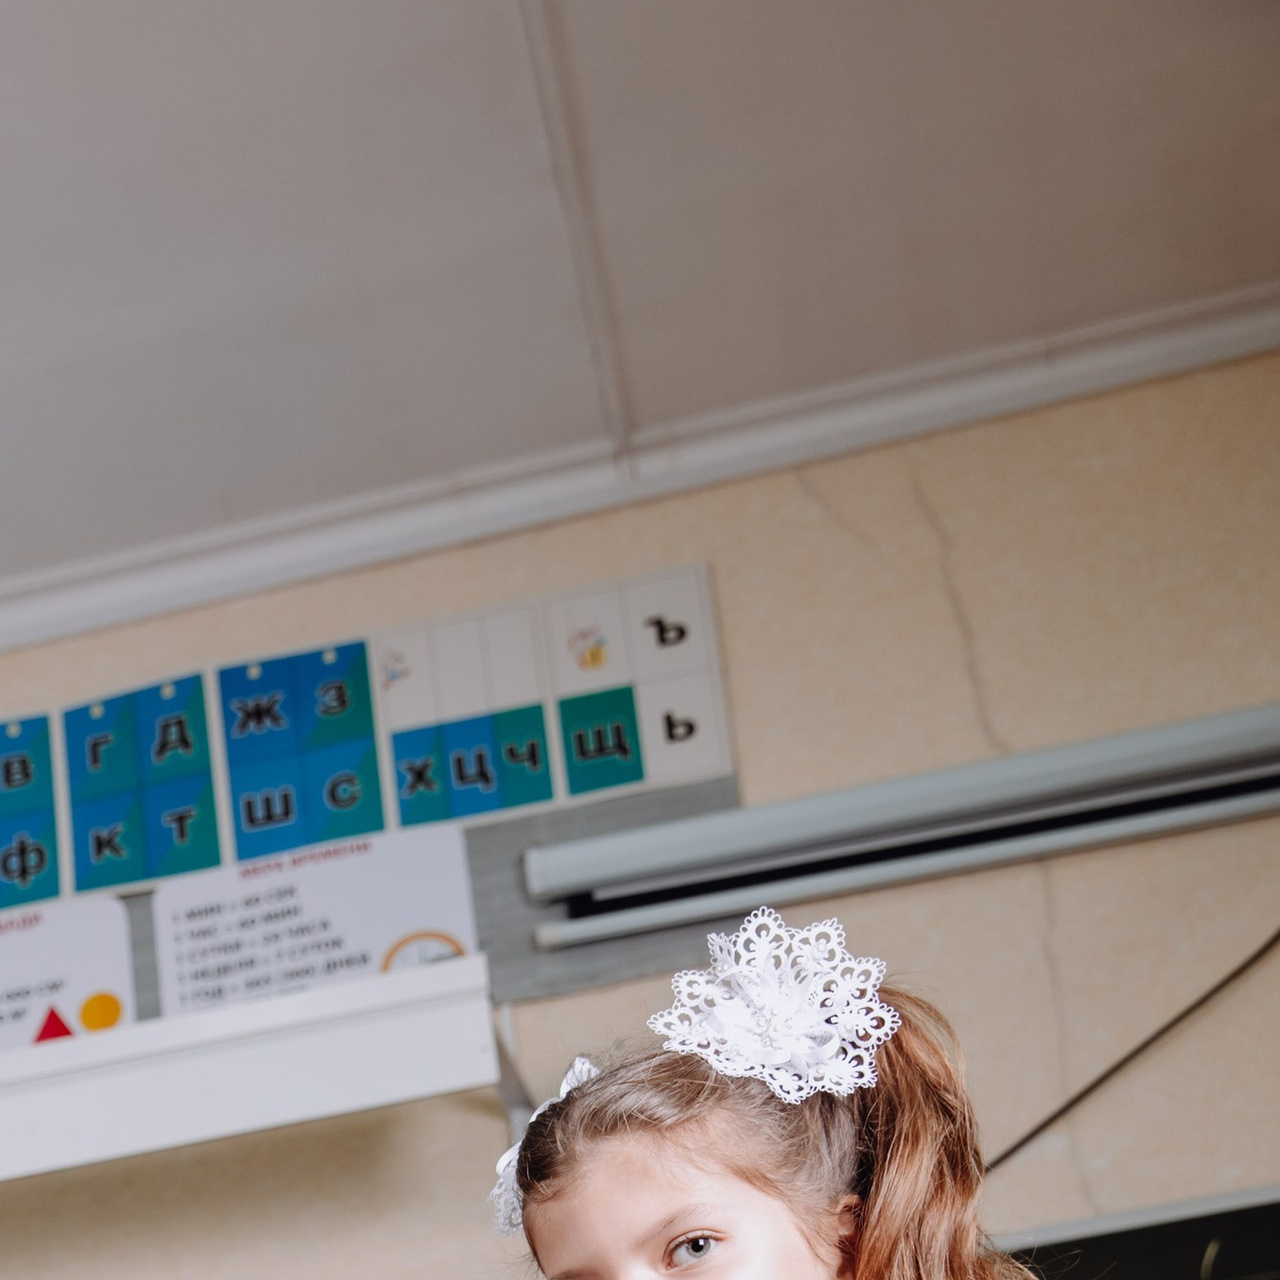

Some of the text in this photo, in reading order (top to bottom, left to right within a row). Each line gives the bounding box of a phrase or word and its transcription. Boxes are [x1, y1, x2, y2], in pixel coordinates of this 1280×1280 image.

[1, 754, 34, 790] в
[89, 733, 116, 770] г
[154, 713, 194, 763] д
[233, 693, 288, 735] ж
[317, 679, 352, 716] з
[643, 614, 689, 649] ъ
[92, 826, 127, 861] к
[164, 808, 198, 845] т
[243, 787, 295, 830] ш
[326, 773, 363, 809] с
[402, 757, 439, 796] х
[453, 748, 494, 791] ц
[505, 736, 541, 771] ч
[574, 720, 633, 762] щ
[662, 709, 698, 745] ь
